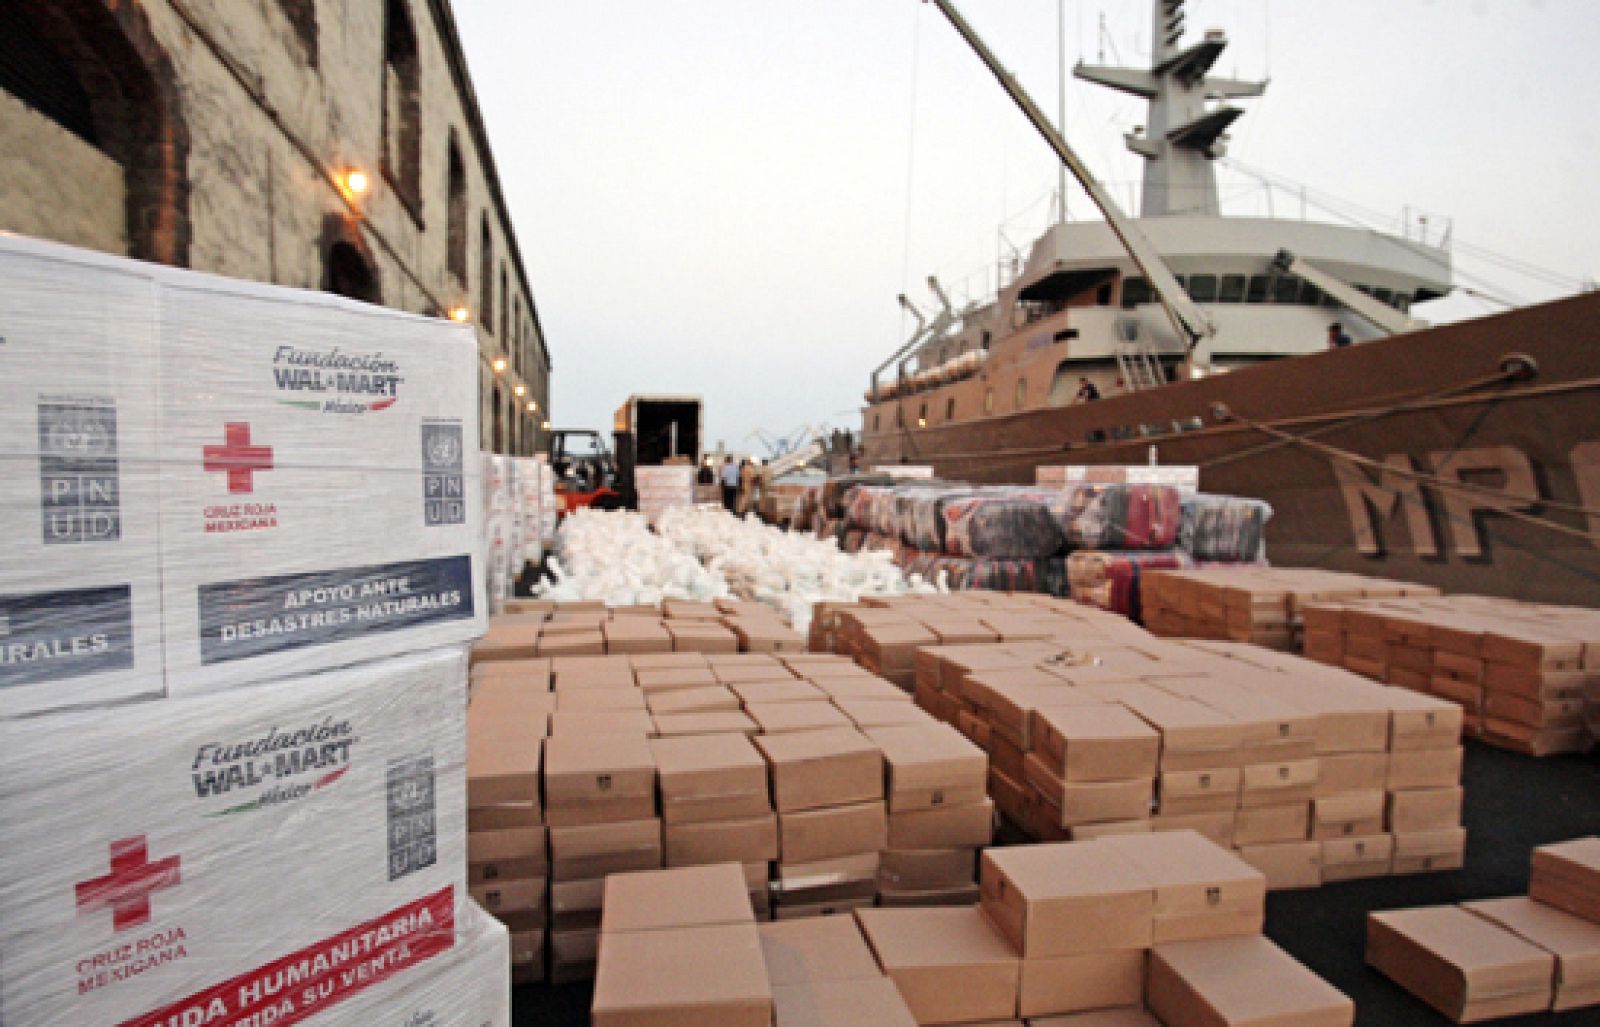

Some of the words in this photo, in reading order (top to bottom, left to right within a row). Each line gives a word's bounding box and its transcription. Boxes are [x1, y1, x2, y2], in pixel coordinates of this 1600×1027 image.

[203, 504, 240, 518] CRUZ
[244, 503, 277, 515] ROJA
[205, 517, 277, 533] MEXICANA
[284, 584, 352, 609] APOYO
[361, 576, 411, 598] ANTE
[221, 608, 350, 642] DESASTRES
[357, 590, 460, 620] NATURALES
[0, 633, 108, 664] RALES
[76, 943, 131, 974] CRUZ
[137, 928, 186, 955] ROJA
[78, 944, 187, 995] MEXICANA
[238, 906, 432, 1009] HUMANITARIA
[302, 976, 333, 1005] SU
[342, 944, 411, 987] VENTA
